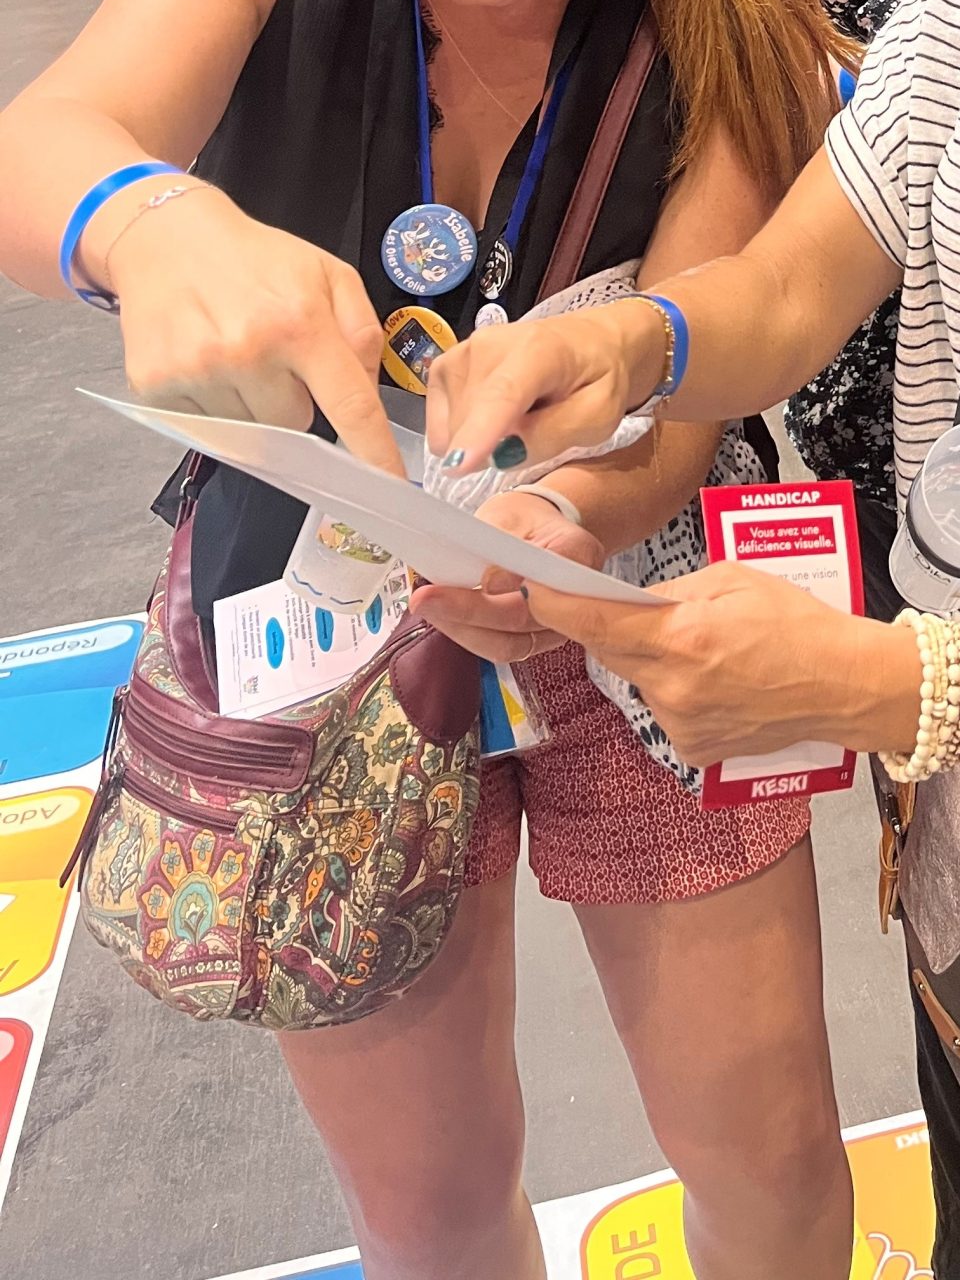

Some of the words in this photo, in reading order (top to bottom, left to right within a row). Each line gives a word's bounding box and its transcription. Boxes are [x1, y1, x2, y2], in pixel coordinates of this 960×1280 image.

[385, 228, 399, 245] Les
[443, 211, 474, 262] Isabelle
[741, 491, 821, 508] HANDICAP
[749, 526, 775, 539] Vous
[777, 527, 799, 537] avez
[801, 526, 820, 536] une
[737, 539, 792, 554] déficience
[794, 535, 834, 550] visuelle.
[792, 571, 809, 582] une
[811, 568, 839, 580] vision
[0, 636, 98, 664] Répond
[751, 774, 809, 798] KESKI
[0, 803, 62, 824] Ado
